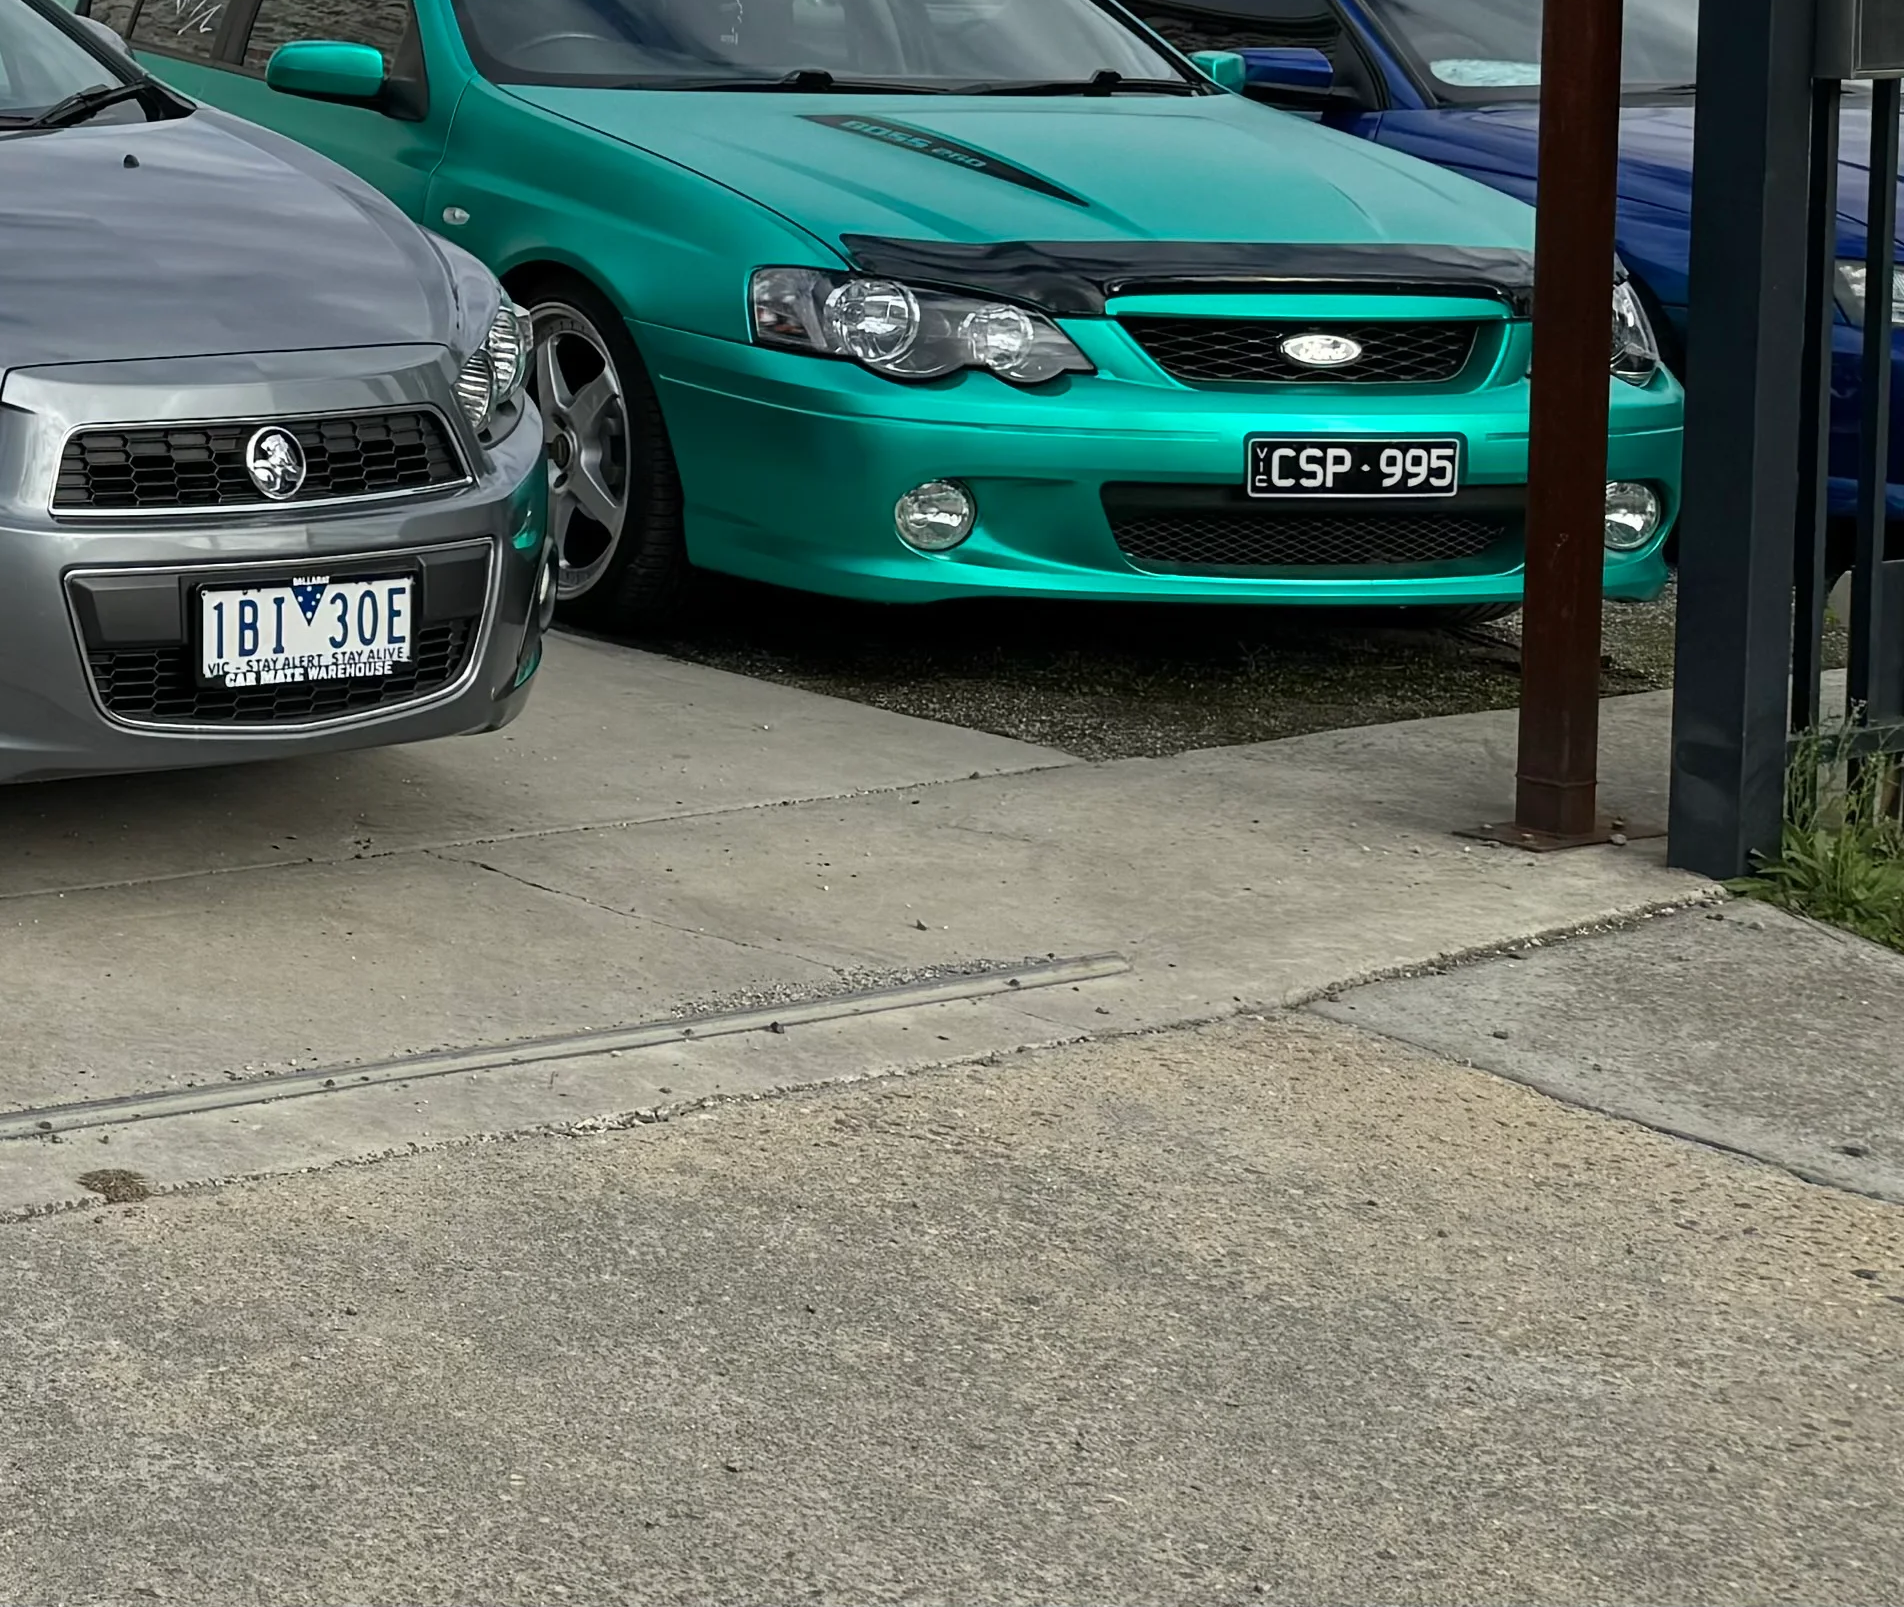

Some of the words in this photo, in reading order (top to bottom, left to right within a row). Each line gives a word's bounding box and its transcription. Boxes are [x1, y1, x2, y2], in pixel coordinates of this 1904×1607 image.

[1271, 447, 1352, 488] CSP
[1379, 448, 1455, 487] 995
[213, 596, 285, 660] 1BI
[208, 661, 230, 676] VIC
[246, 658, 279, 673] STAY
[282, 654, 323, 670] ALERT
[332, 650, 363, 664] STAY
[367, 646, 404, 661] ALIVE
[225, 671, 257, 688] CAR
[260, 668, 305, 685] MATE
[307, 660, 393, 680] WAREHOUSE
